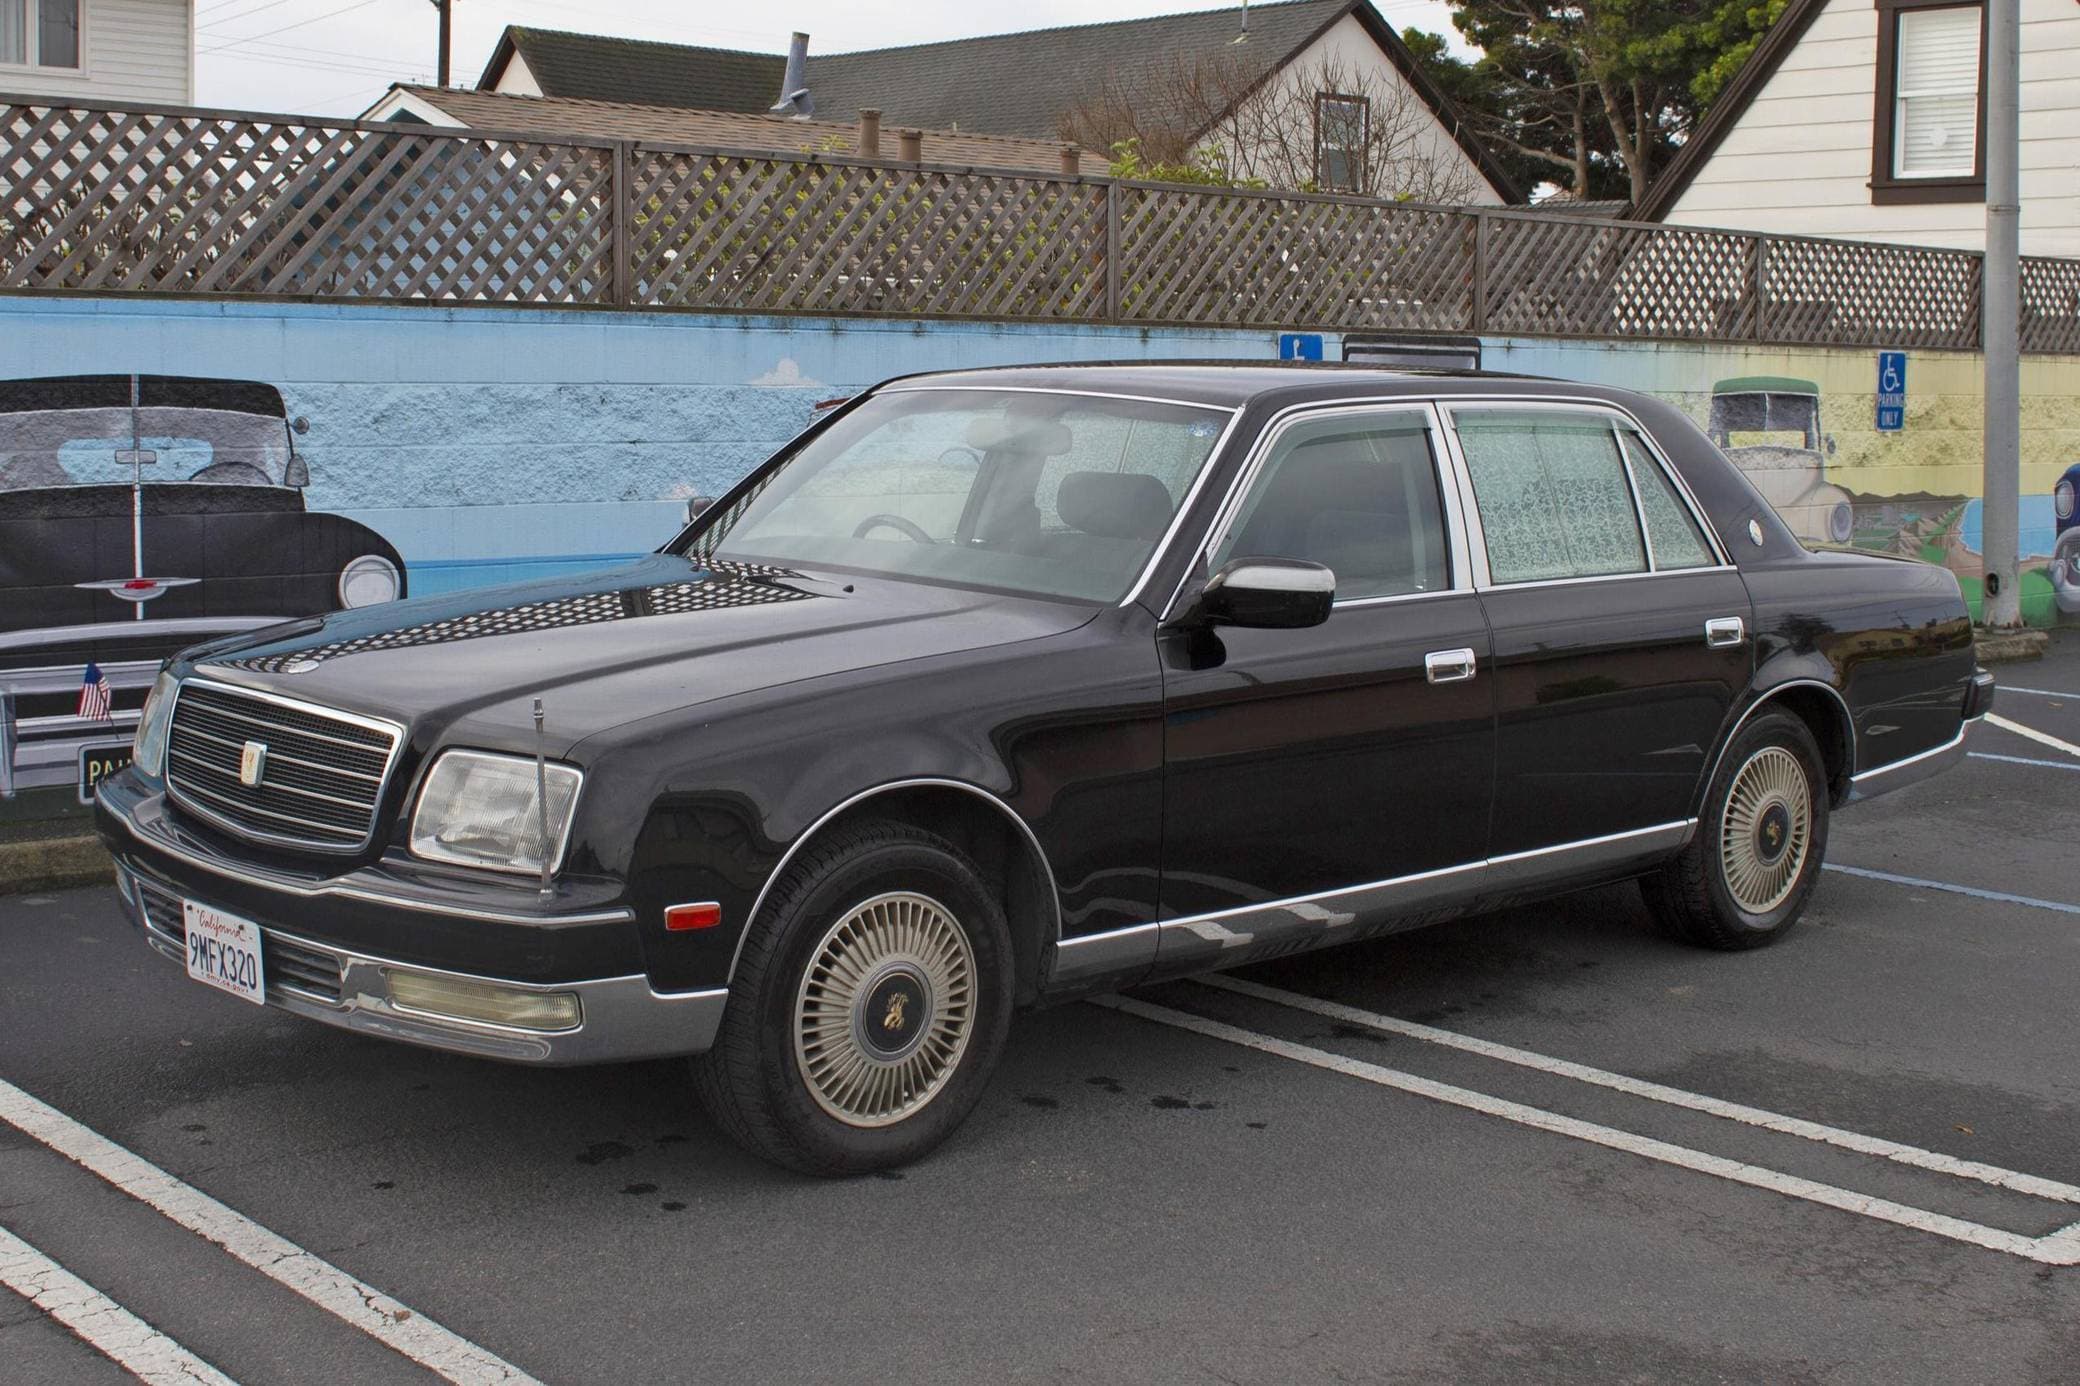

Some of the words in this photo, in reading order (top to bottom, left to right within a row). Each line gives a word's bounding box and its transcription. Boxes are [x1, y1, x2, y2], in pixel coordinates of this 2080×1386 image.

[1878, 392, 1904, 408] PARKING
[1881, 411, 1899, 426] ONLY
[199, 909, 246, 942] California
[190, 931, 257, 990] 9MFX320
